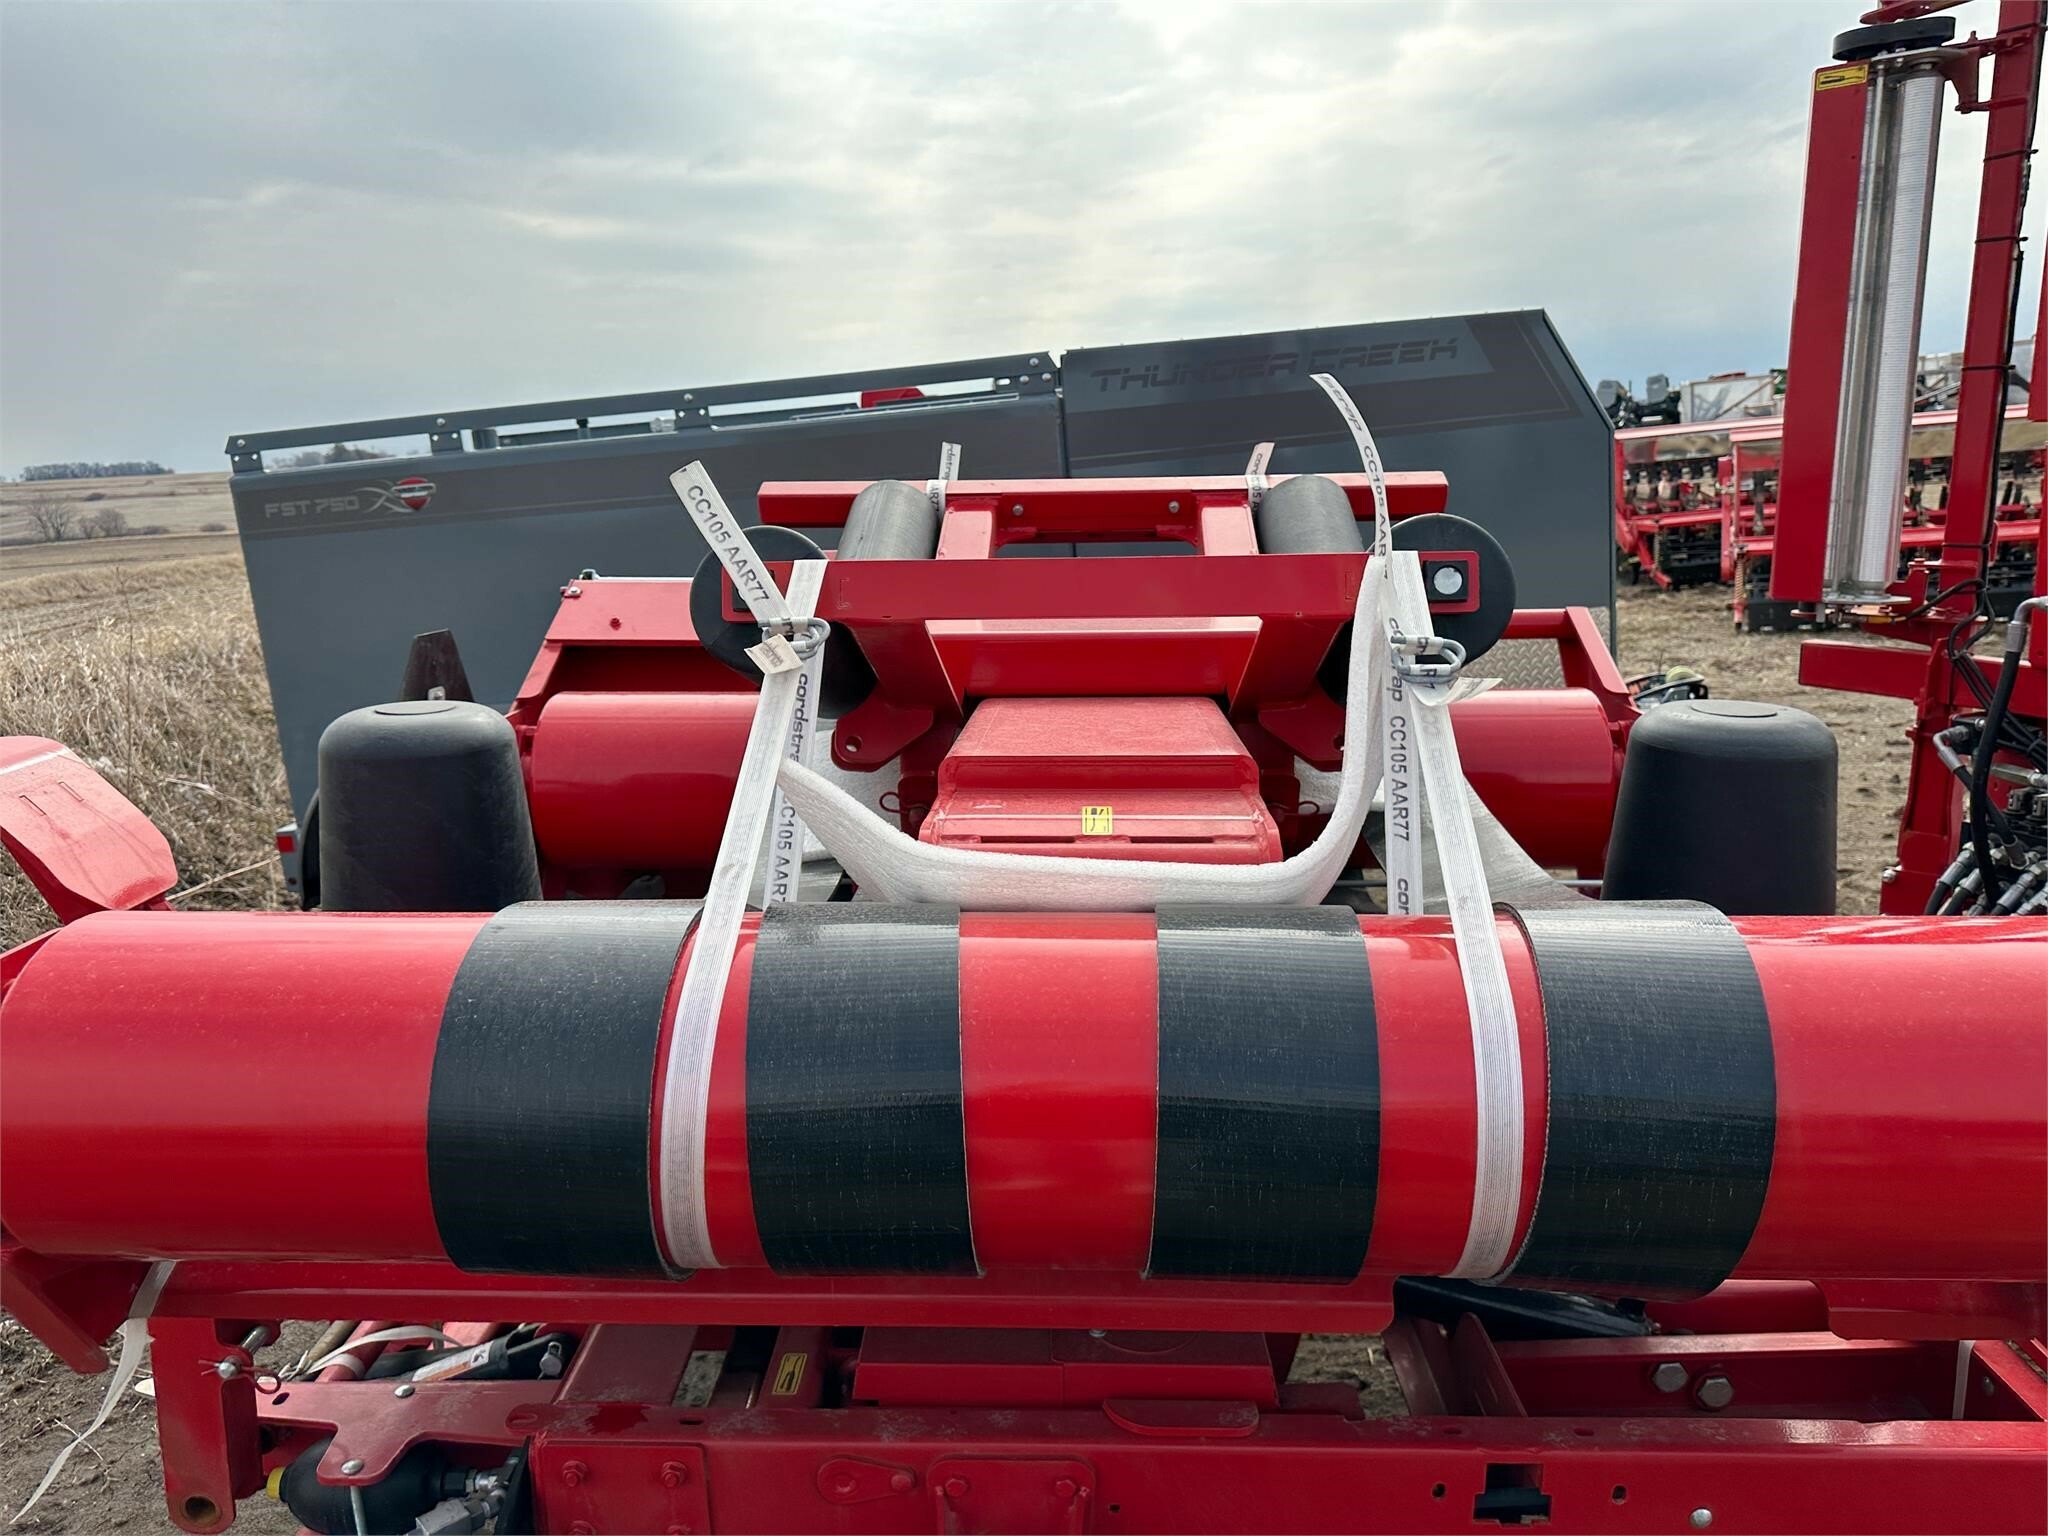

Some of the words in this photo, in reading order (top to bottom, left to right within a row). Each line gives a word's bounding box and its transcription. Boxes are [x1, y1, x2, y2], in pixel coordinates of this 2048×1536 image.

[1090, 351, 1298, 393] THUNDER
[1308, 337, 1459, 371] CREEK
[1364, 445, 1385, 506] CC105
[265, 500, 311, 519] FST
[314, 495, 360, 514] 750
[687, 484, 732, 544] CC105
[723, 546, 770, 602] AAR77
[789, 673, 809, 763] cordstra
[1389, 715, 1408, 774] CC105
[777, 800, 796, 850] C105
[1391, 777, 1410, 842] AAR77
